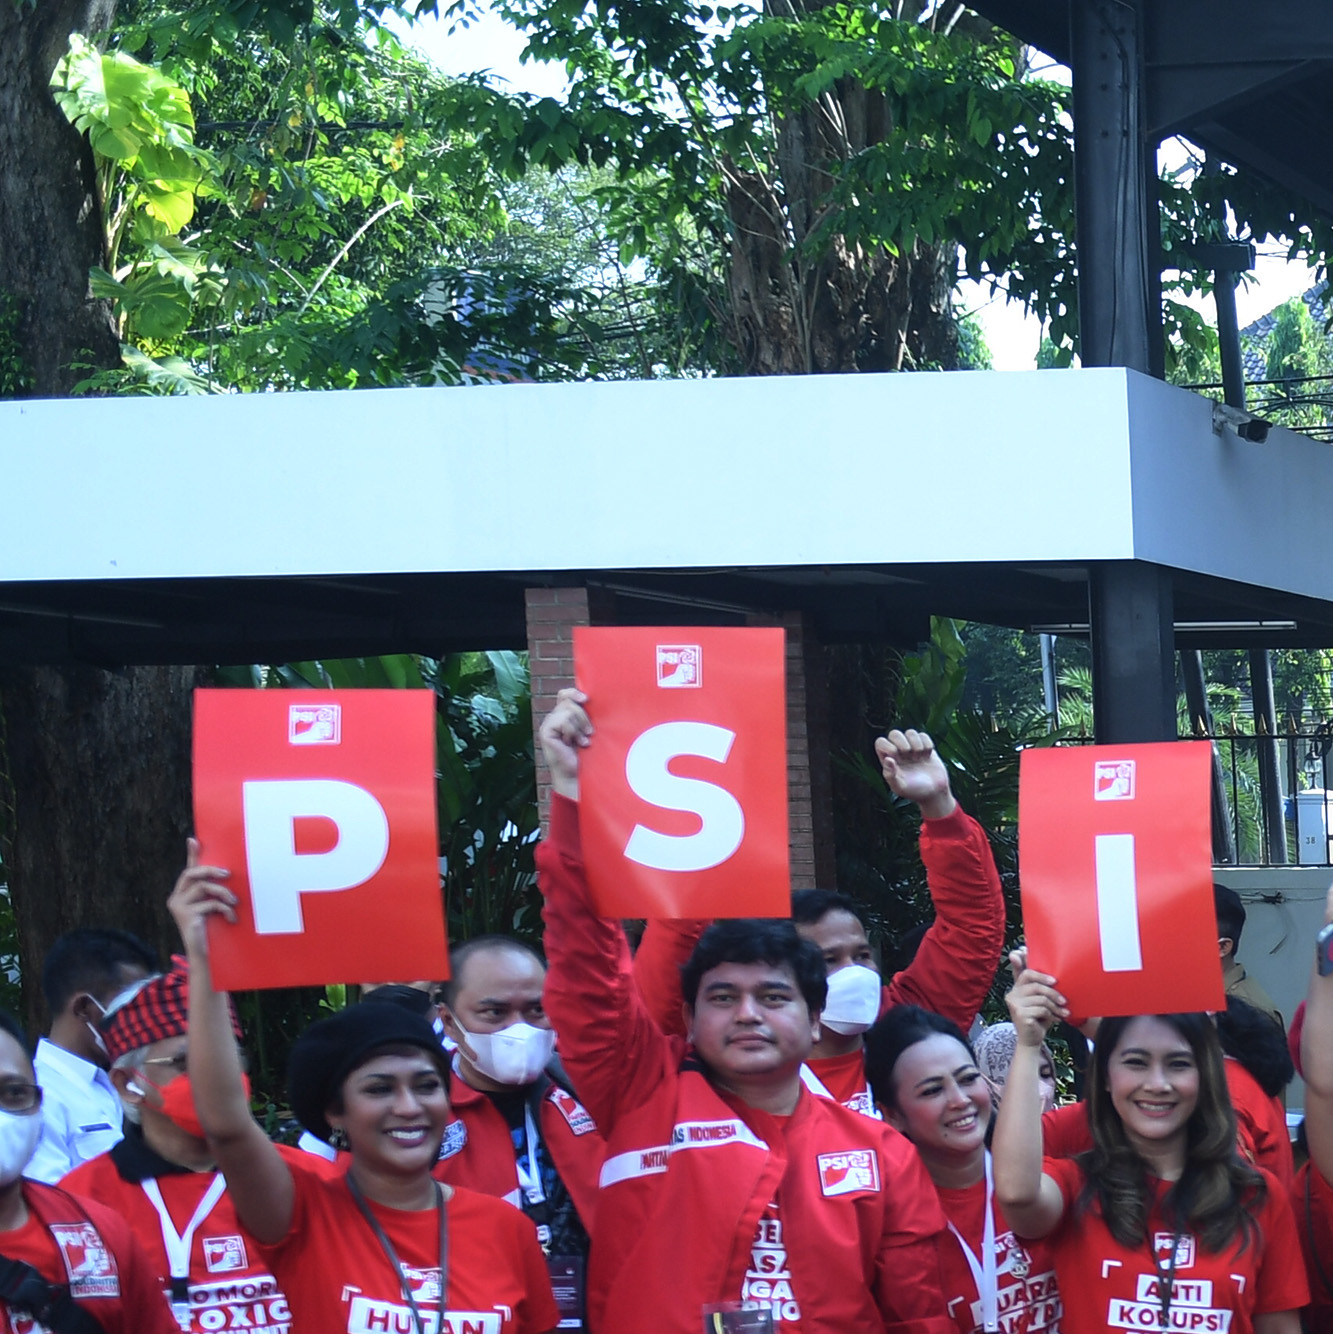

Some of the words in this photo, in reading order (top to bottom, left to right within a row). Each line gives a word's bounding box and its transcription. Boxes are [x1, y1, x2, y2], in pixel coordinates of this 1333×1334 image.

[624, 721, 745, 872] S
[242, 780, 389, 935] P
[1305, 836, 1316, 845] 38
[821, 1156, 849, 1171] PSI
